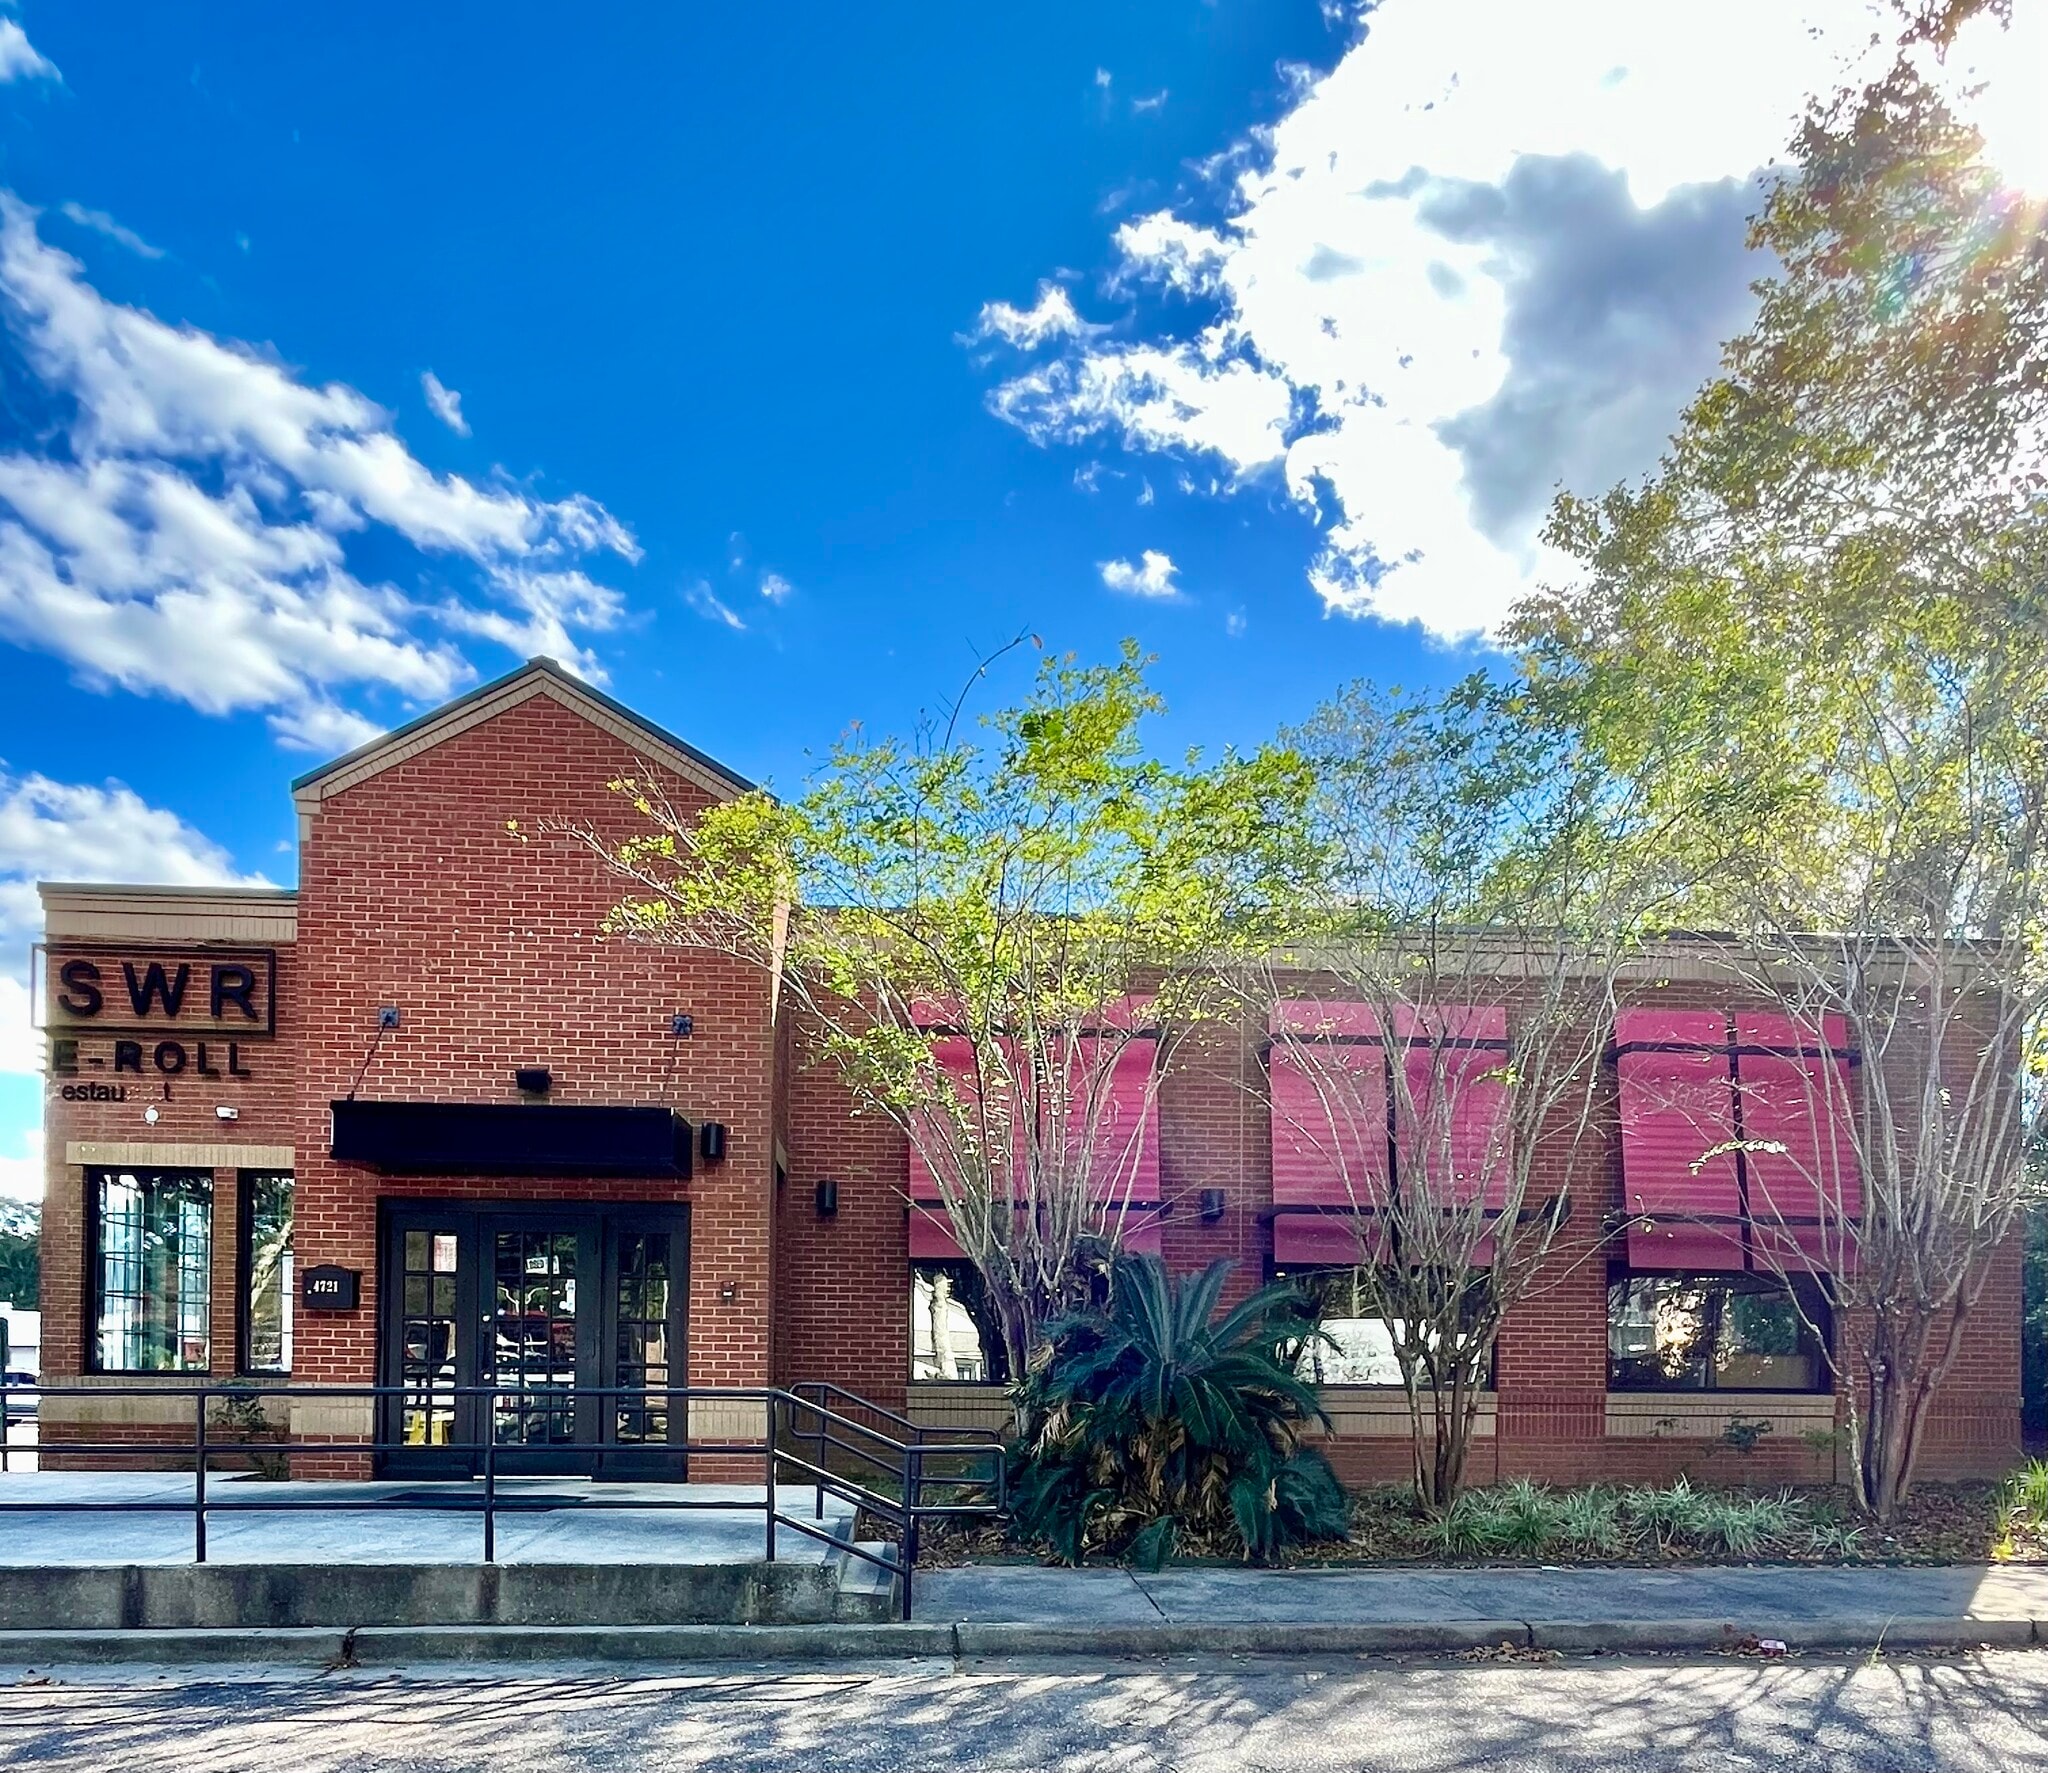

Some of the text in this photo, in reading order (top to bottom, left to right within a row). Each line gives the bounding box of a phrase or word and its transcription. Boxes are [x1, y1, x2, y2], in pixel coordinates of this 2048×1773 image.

[57, 959, 258, 1022] SWR
[52, 1039, 251, 1077] E-ROLL
[312, 1279, 339, 1293] 4721
